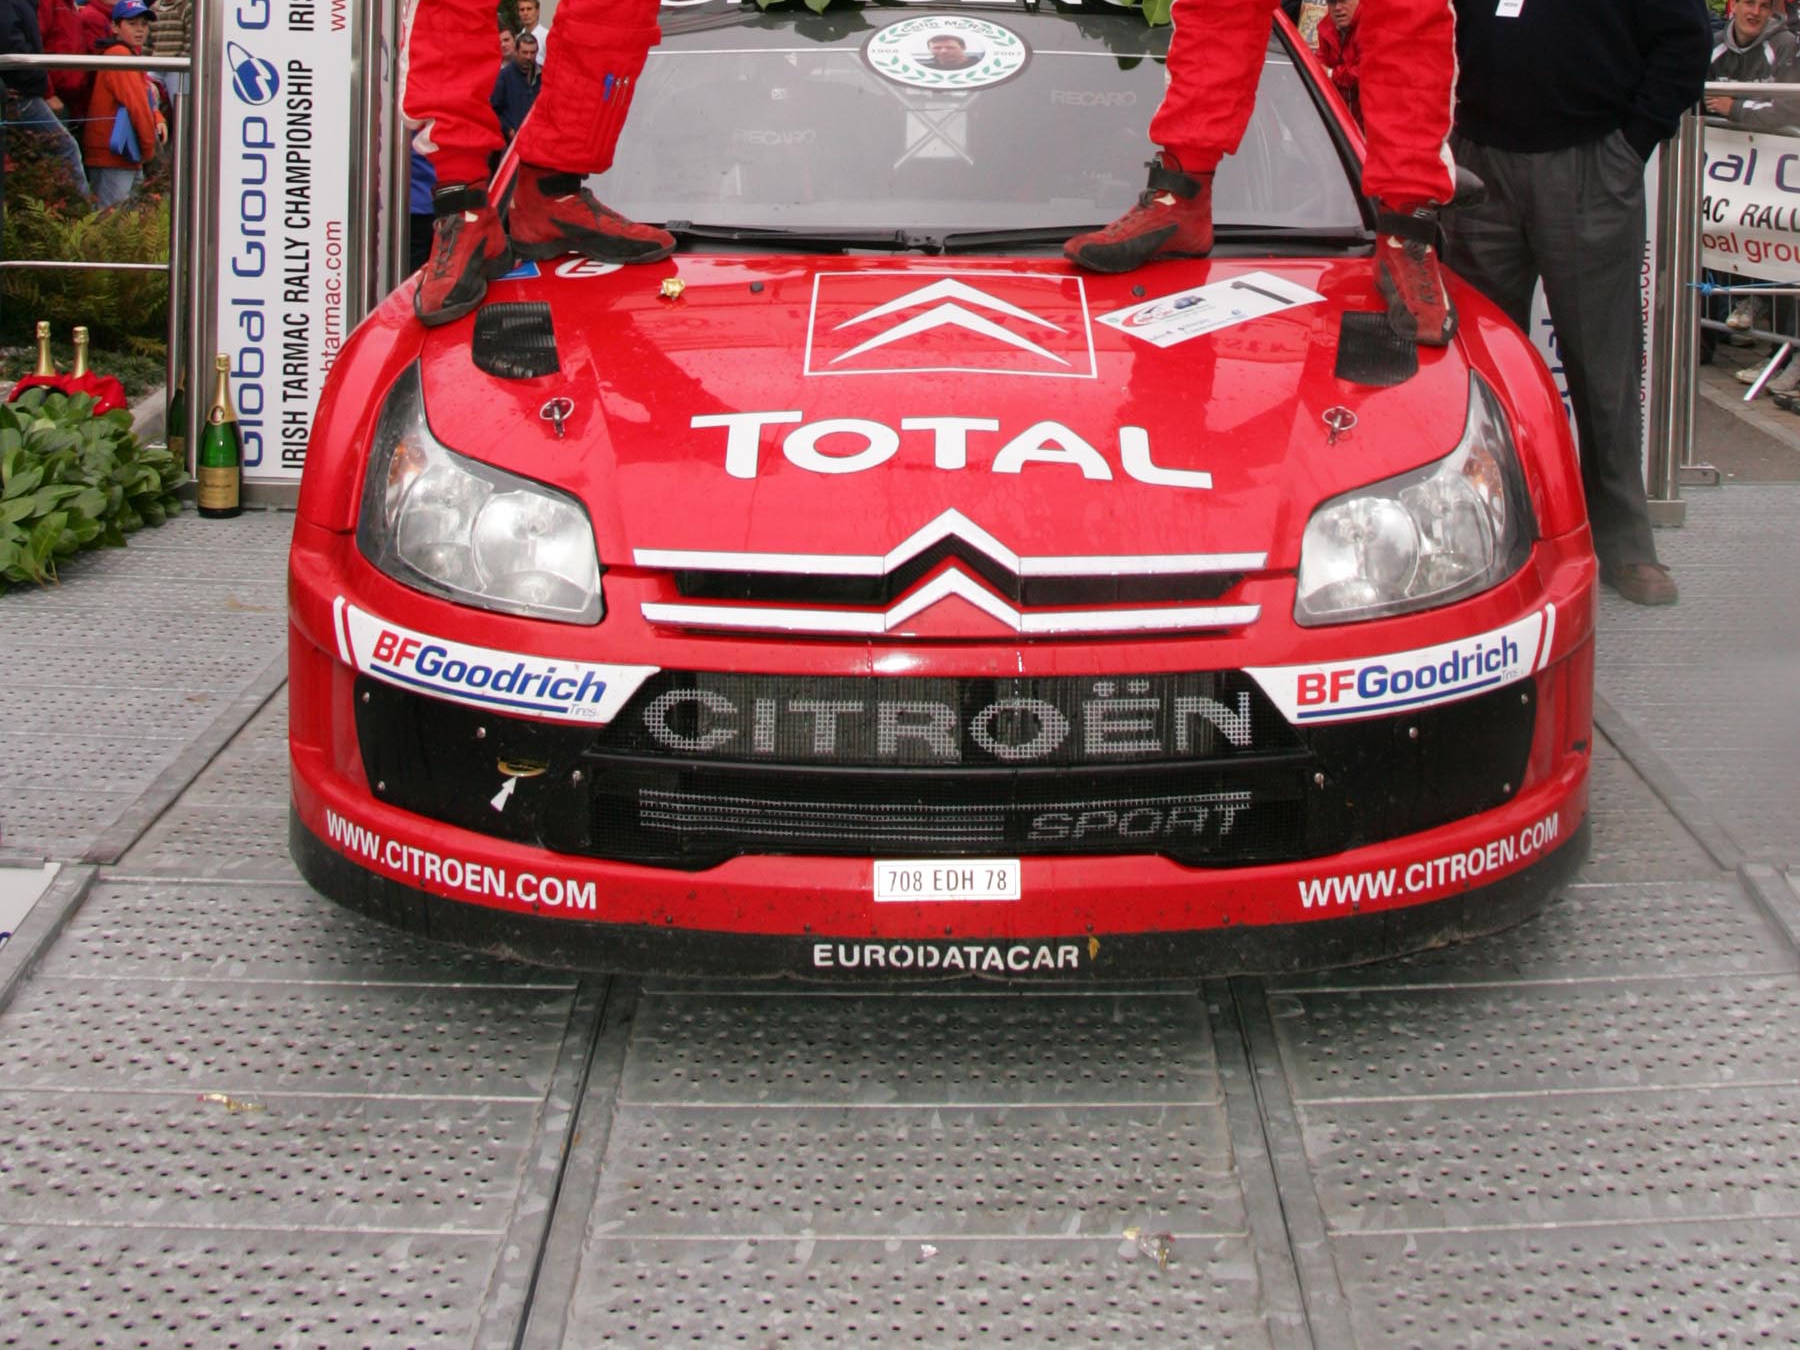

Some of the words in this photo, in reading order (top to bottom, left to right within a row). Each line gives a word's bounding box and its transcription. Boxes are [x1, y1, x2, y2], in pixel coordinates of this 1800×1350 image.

[1050, 90, 1137, 107] RECARO
[284, 59, 313, 229] CHAMPIONSHIP
[232, 116, 276, 278] Group
[284, 237, 310, 303] RALLY
[1744, 238, 1800, 264] grou
[230, 298, 265, 468] Global
[282, 313, 310, 403] TARMAC
[281, 411, 308, 469] IRISH
[690, 410, 1213, 489] TOTAL
[372, 630, 607, 704] BFGoodrich
[1297, 636, 1518, 707] BFGoodrich
[642, 679, 1253, 760] CITROËN
[326, 809, 597, 910] WWW.CITROEN.COM
[1028, 804, 1250, 841] SPORT
[888, 870, 923, 892] 708
[933, 869, 974, 891] EDH
[985, 869, 1007, 891] 78
[1298, 812, 1559, 908] WWW.CITROEN.COM
[813, 944, 1079, 970] EURODATACAR
